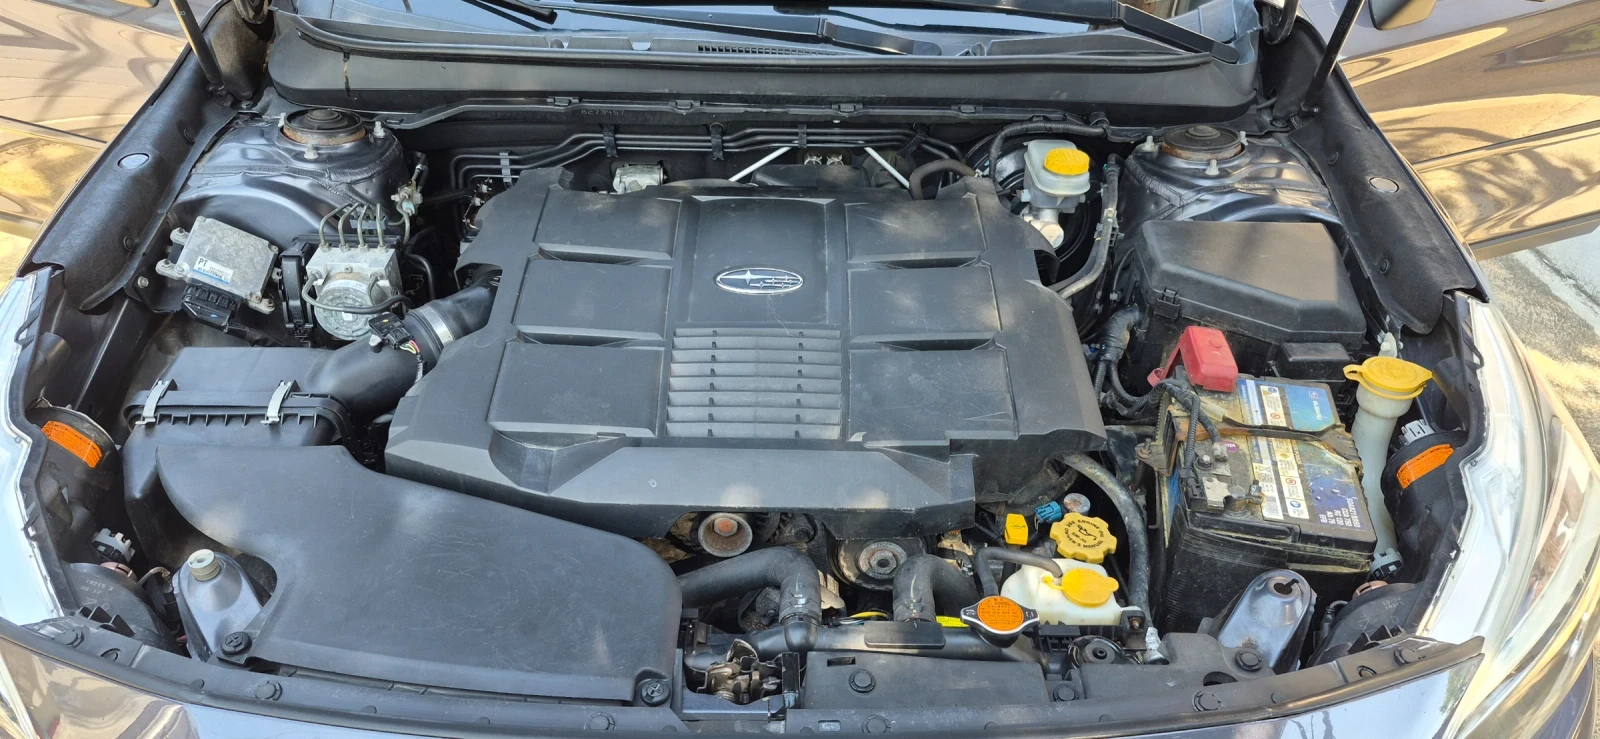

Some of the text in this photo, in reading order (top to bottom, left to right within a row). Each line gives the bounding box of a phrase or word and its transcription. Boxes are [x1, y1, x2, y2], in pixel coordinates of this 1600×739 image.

[198, 258, 208, 267] PT
[1078, 520, 1100, 530] ENGINE
[1082, 540, 1104, 548] MANUAL
